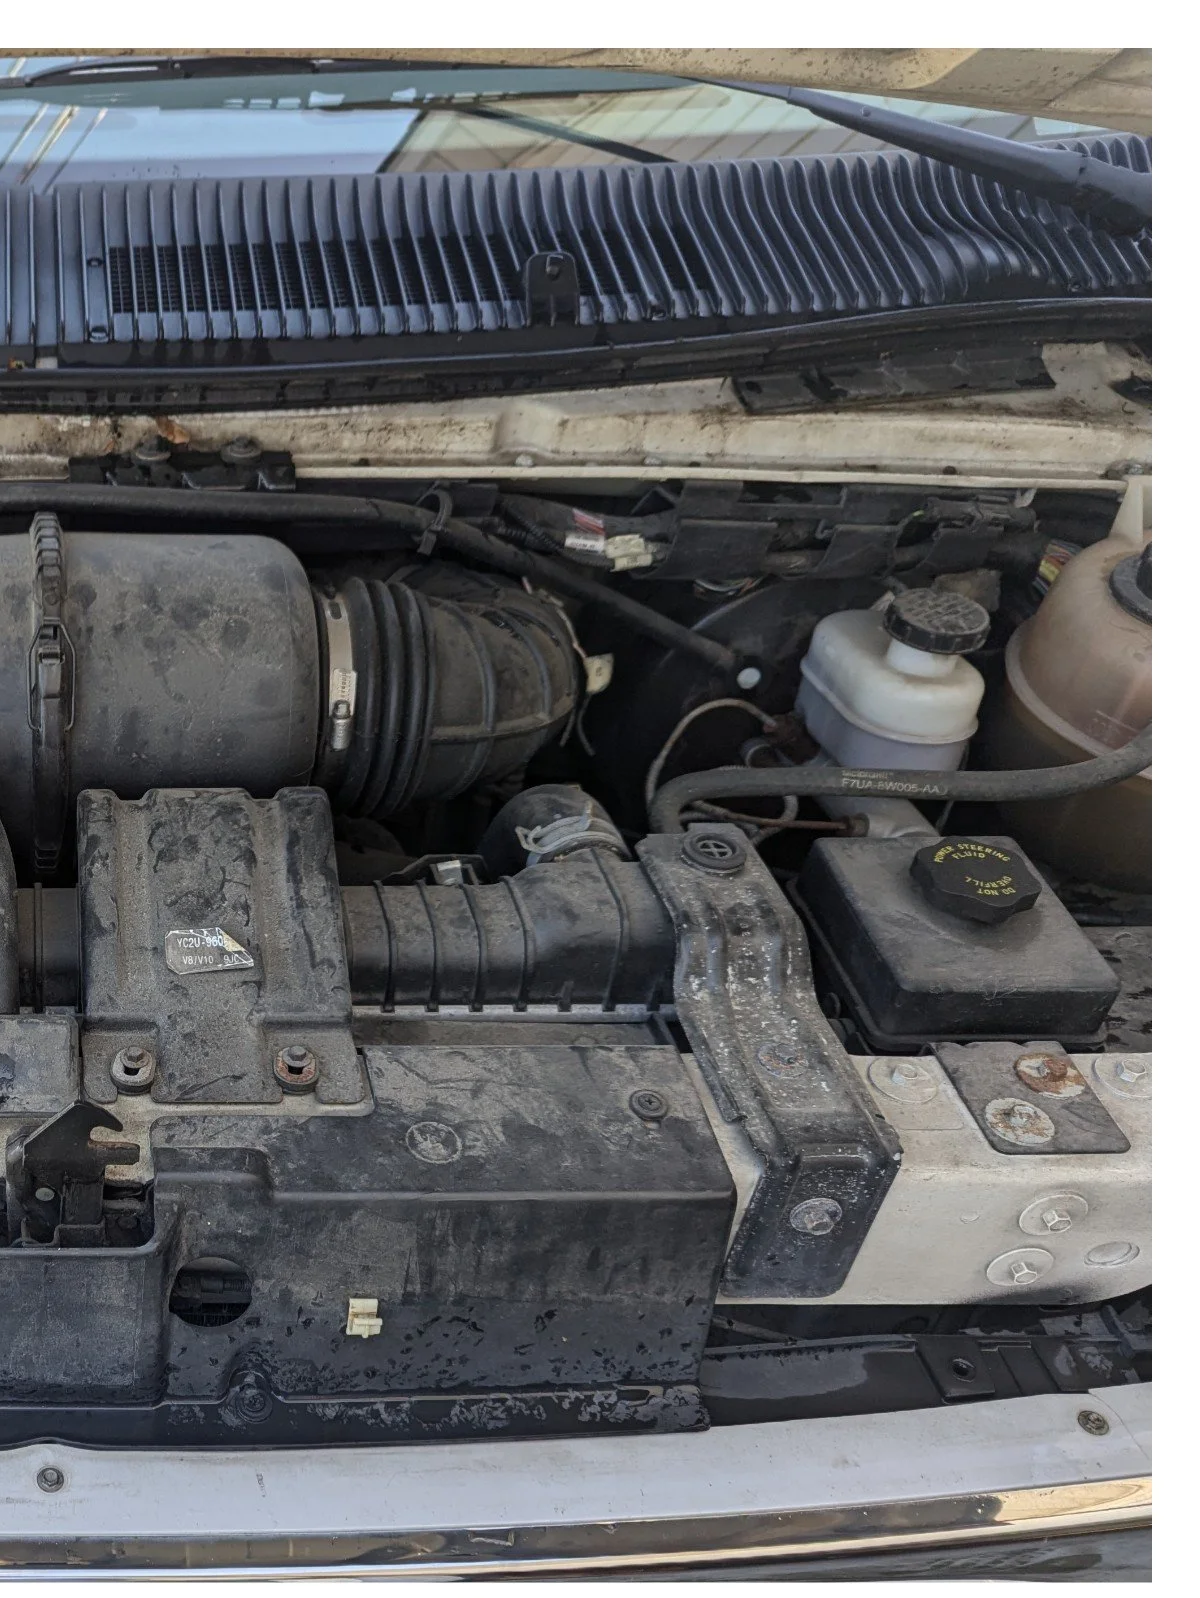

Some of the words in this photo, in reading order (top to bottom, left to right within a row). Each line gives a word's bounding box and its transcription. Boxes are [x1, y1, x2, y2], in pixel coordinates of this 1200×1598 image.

[934, 845, 955, 863] POWER
[957, 843, 1011, 862] STEERING
[951, 851, 986, 860] FLUID
[965, 875, 1012, 888] OVERFILL
[976, 888, 999, 896] NOT
[1001, 887, 1017, 895] DO
[182, 955, 215, 966] V8/V10
